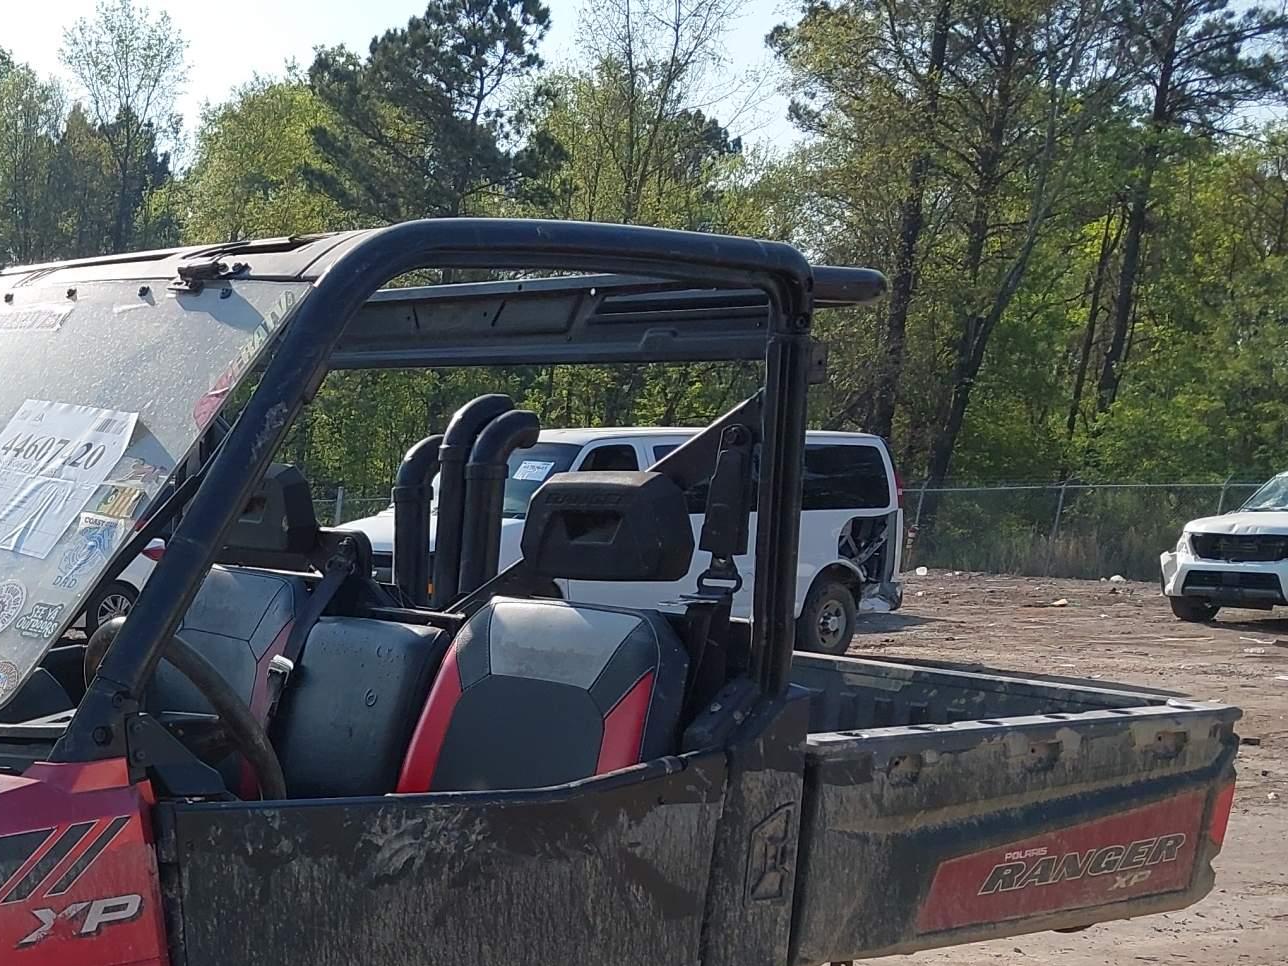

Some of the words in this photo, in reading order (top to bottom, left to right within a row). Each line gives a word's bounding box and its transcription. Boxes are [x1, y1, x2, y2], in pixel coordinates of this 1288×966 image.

[1, 432, 106, 470] 44607420
[84, 516, 105, 527] COAST
[52, 575, 77, 589] DAD
[26, 605, 48, 619] SEE
[46, 606, 62, 621] YA
[15, 616, 59, 638] OUTDOORS
[977, 833, 1186, 896] RANGER
[1004, 846, 1048, 862] POLARIS
[1107, 868, 1152, 892] XP
[16, 892, 144, 949] XP
